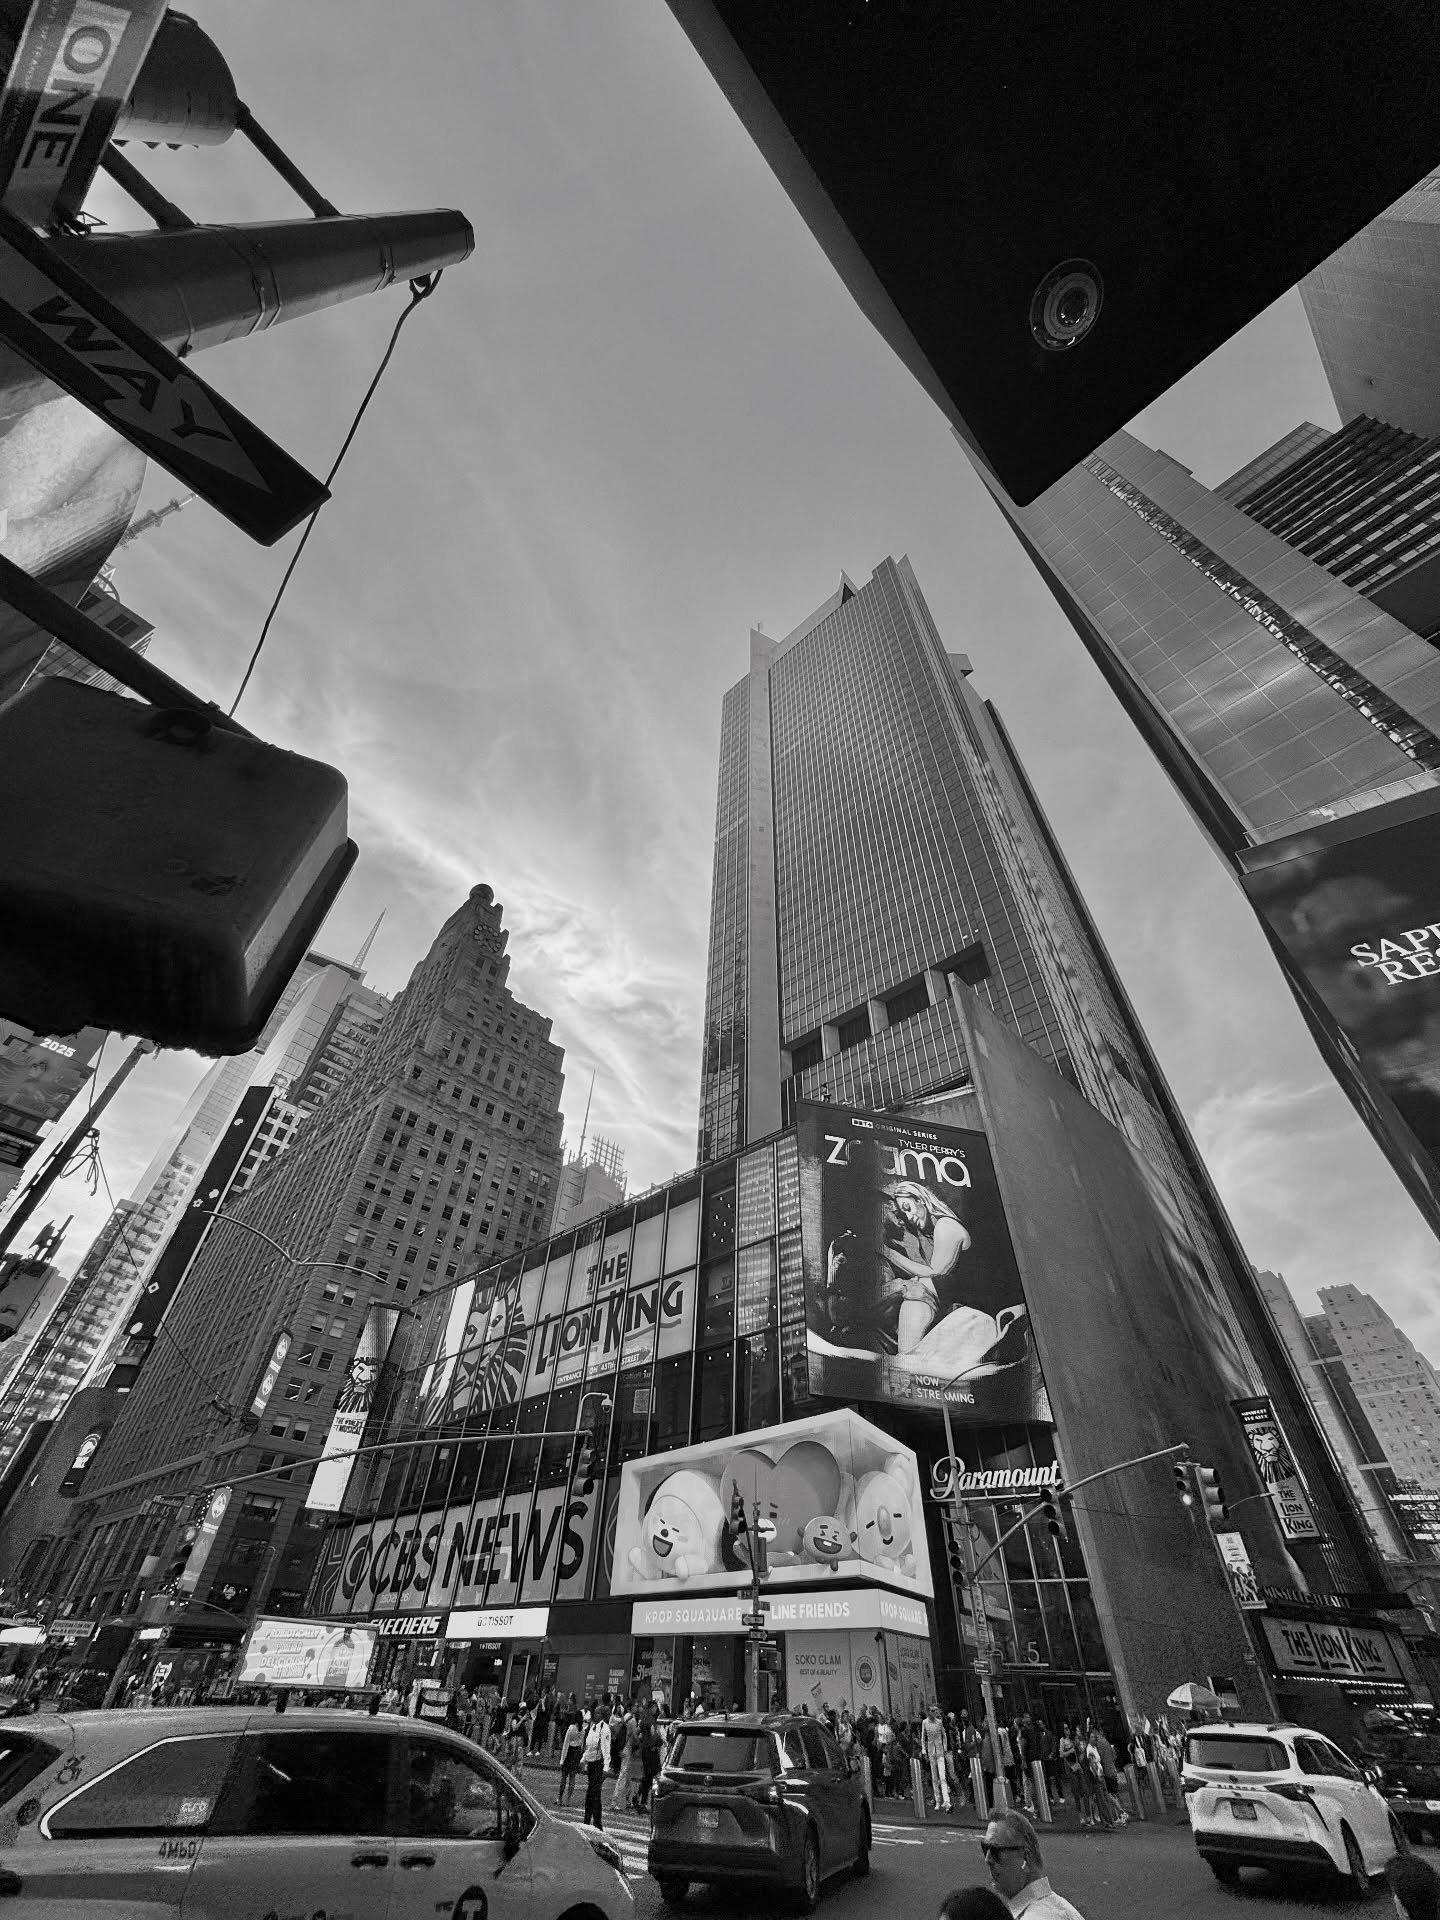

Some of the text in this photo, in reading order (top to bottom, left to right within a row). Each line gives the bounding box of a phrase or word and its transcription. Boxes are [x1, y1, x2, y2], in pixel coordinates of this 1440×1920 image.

[22, 25, 111, 168] ONE
[29, 294, 232, 442] WAY
[1374, 943, 1440, 985] RE
[40, 1038, 76, 1057] 2025
[875, 1123, 911, 1136] ORIGINAL
[913, 1130, 938, 1140] SERIES
[898, 1139, 966, 1158] TYLER PERRY'S
[587, 1252, 627, 1290] THE
[535, 1281, 683, 1376] LION KING
[914, 1375, 939, 1387] NOW
[929, 1455, 1063, 1499] Paramount
[1280, 1490, 1296, 1499] THE
[1283, 1518, 1314, 1535] KING
[369, 1524, 444, 1595] CBS
[441, 1501, 588, 1589] NEWS
[645, 1609, 673, 1624] KPOP
[771, 1604, 797, 1620] LINE
[799, 1602, 850, 1619] FRIENDS
[880, 1601, 898, 1618] KPOP
[488, 1615, 514, 1625] TISSOT
[795, 1654, 841, 1665] SOKO GLAM
[1281, 1624, 1383, 1675] THE LION KING
